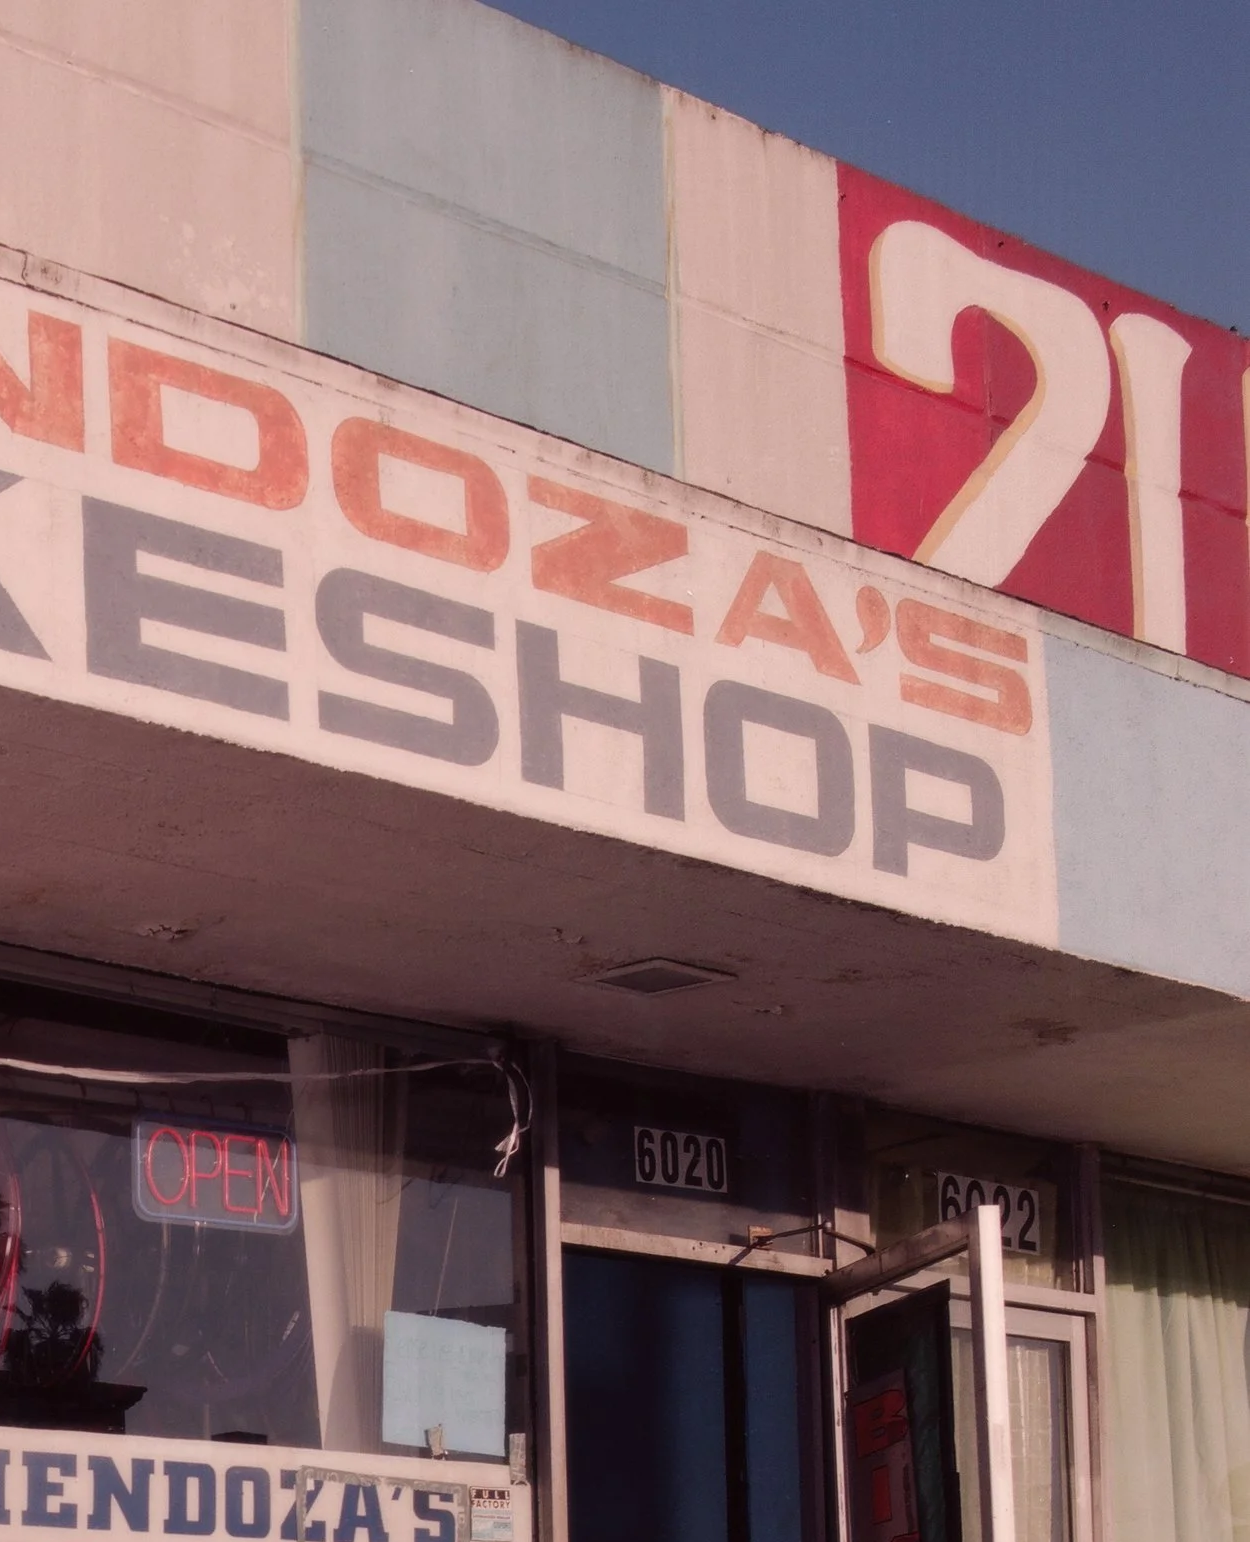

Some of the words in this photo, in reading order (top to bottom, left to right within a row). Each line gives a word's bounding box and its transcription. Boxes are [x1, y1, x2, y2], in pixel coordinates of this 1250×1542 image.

[869, 220, 1250, 656] 21
[145, 1127, 289, 1217] OPEN
[637, 1127, 726, 1190] 6020
[470, 1488, 510, 1499] FULL
[471, 1499, 511, 1509] FACTORY
